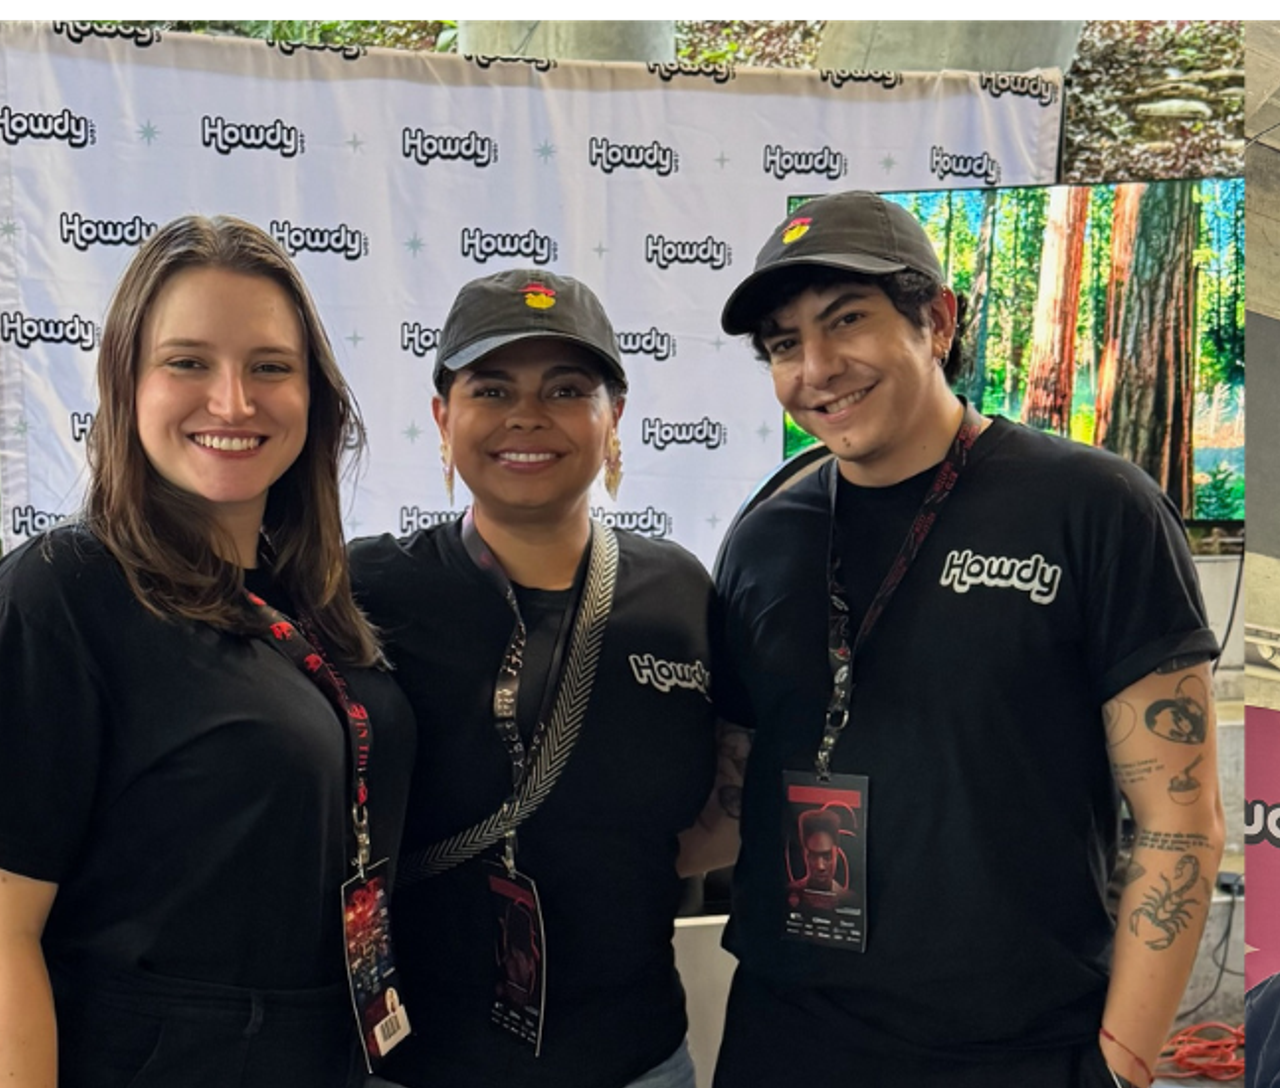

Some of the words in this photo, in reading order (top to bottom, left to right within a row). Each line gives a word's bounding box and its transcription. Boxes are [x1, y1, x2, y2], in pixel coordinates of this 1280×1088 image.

[980, 72, 1054, 106] Howdy
[201, 116, 299, 157] Howdy
[402, 127, 492, 168] Howdy
[588, 137, 673, 177] Howdy
[763, 144, 843, 179] Howdy
[931, 145, 999, 187] Howdy
[270, 220, 362, 260] Howdy
[461, 227, 551, 264] Howdy
[646, 234, 726, 271] Howdy
[1, 311, 95, 351] Howdy
[643, 417, 723, 450] Howdy
[940, 549, 1063, 604] Howdy
